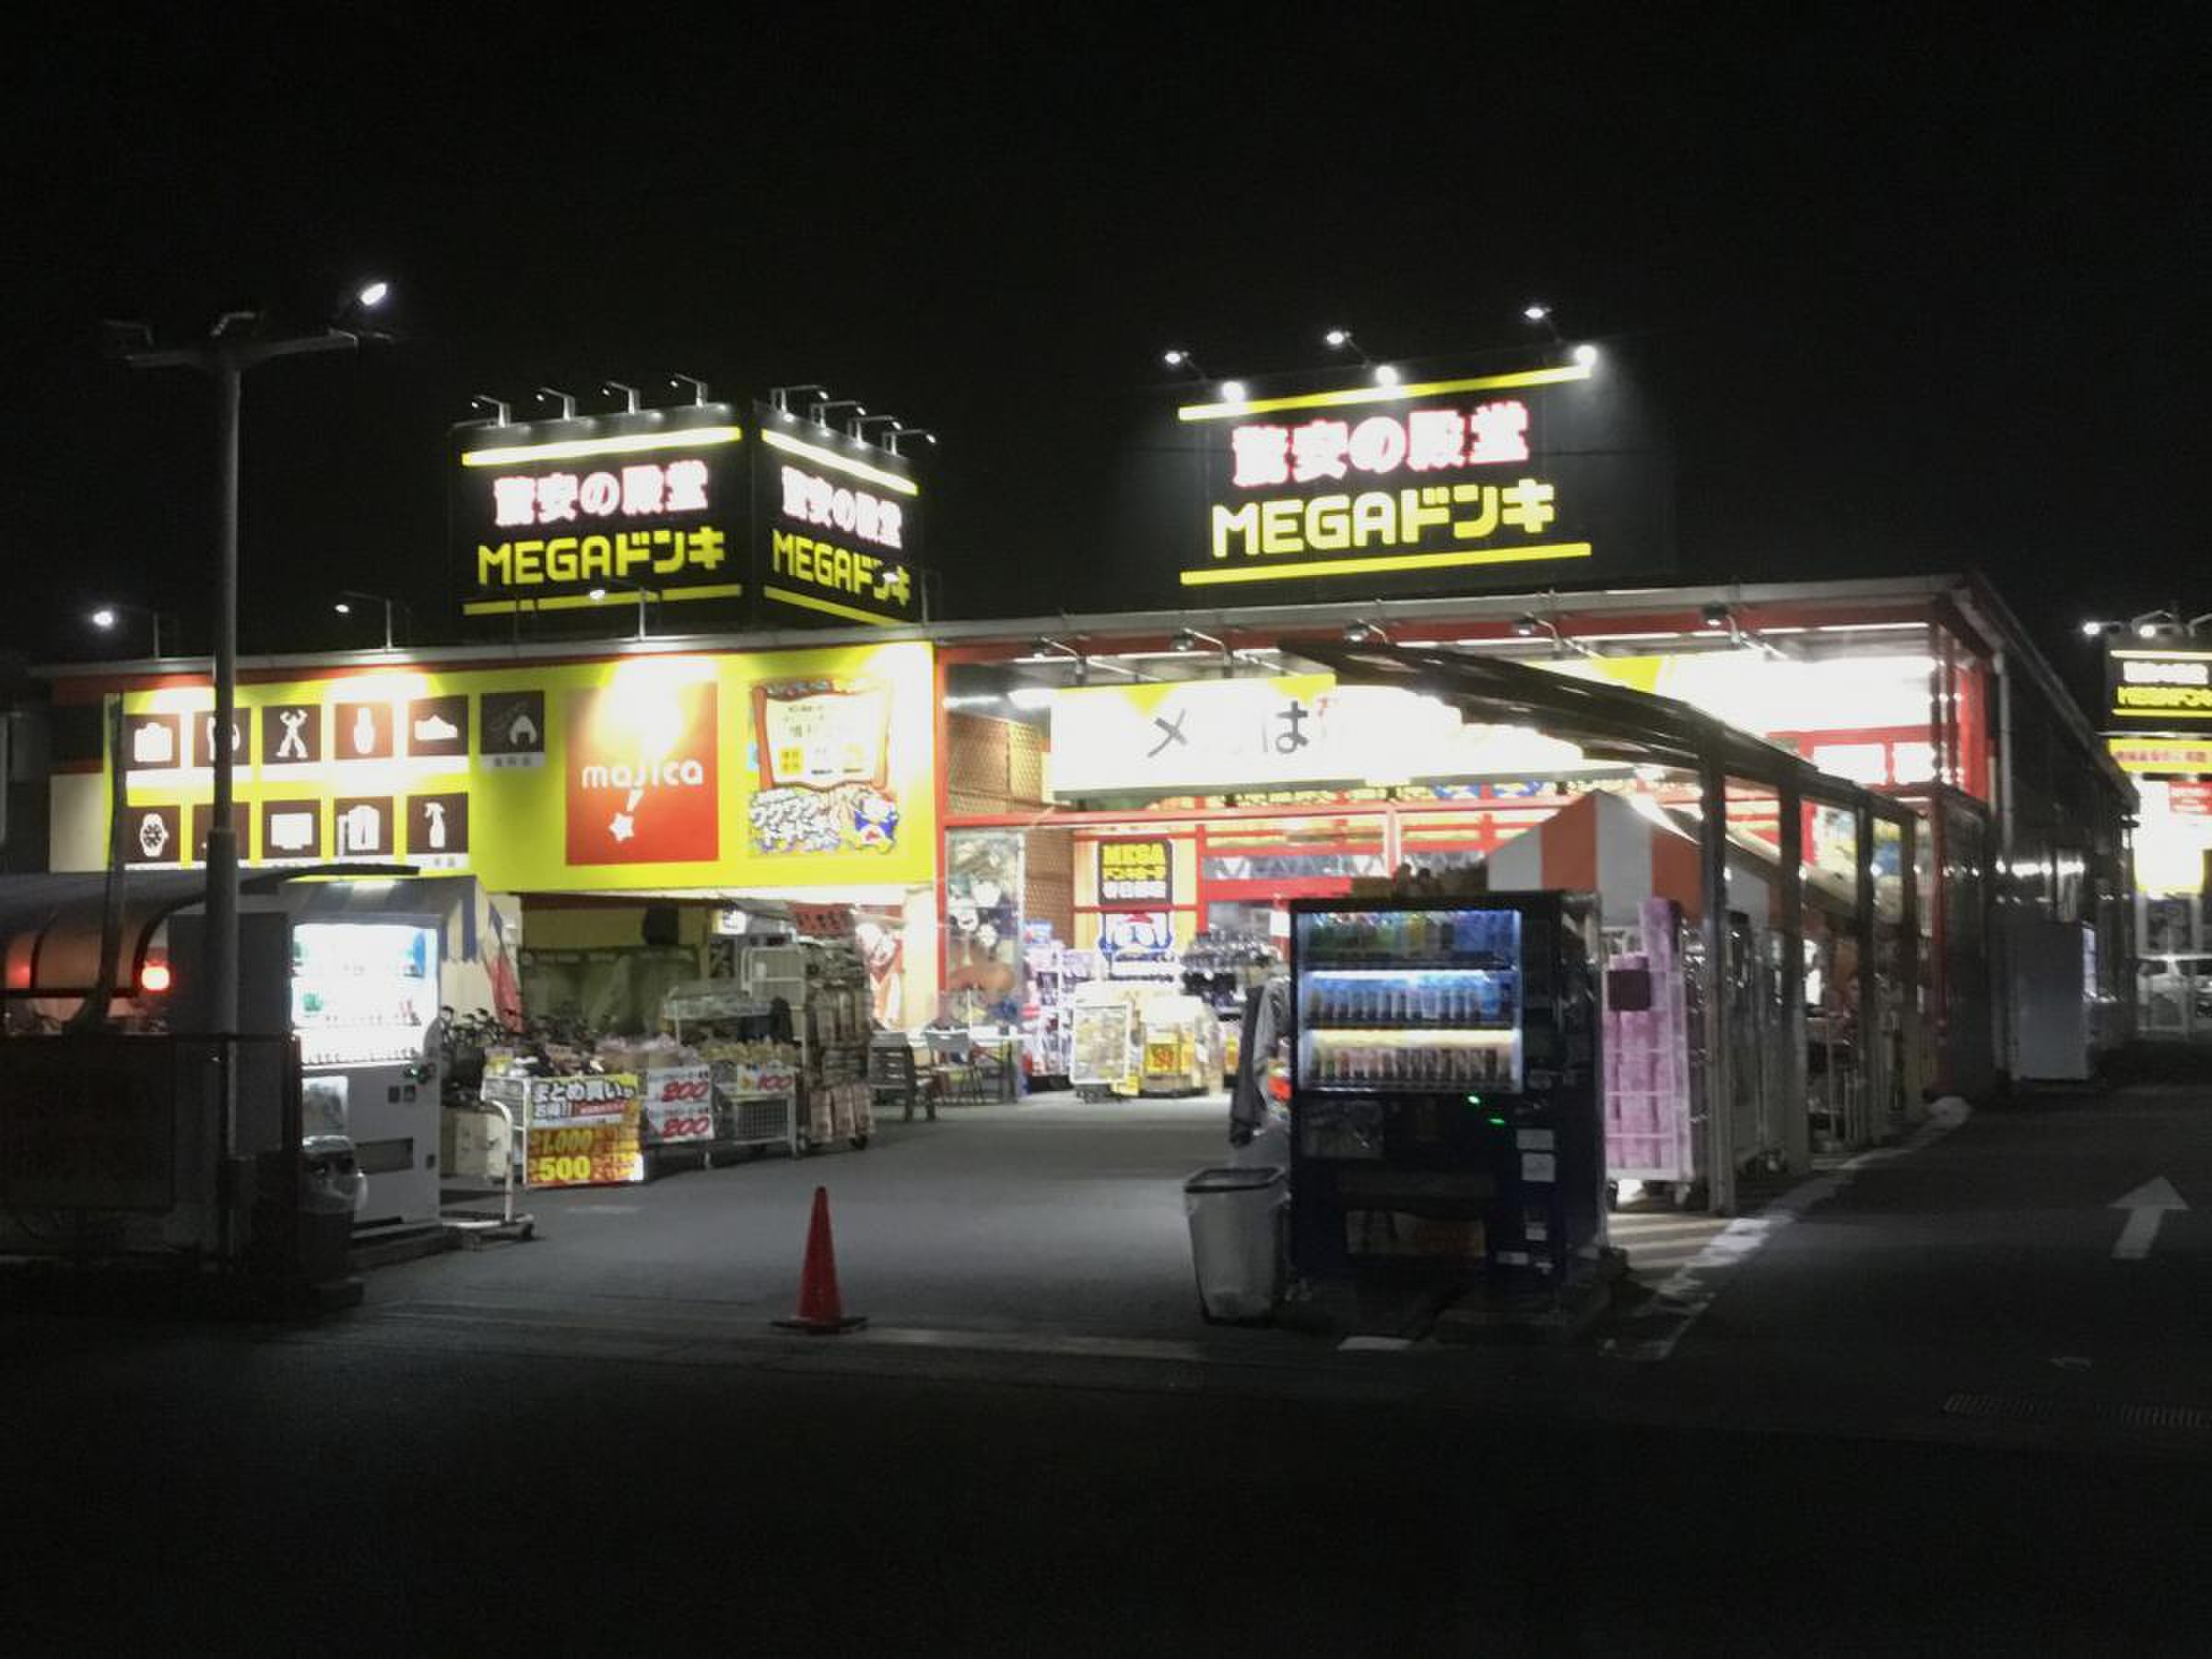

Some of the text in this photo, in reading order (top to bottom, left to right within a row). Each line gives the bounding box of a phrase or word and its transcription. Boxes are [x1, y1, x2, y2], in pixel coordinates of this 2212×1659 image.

[1211, 478, 1555, 559] MEGAドンキ
[477, 526, 725, 586] MEGAドンキ
[582, 759, 705, 790] majica
[538, 1156, 591, 1181] 500
